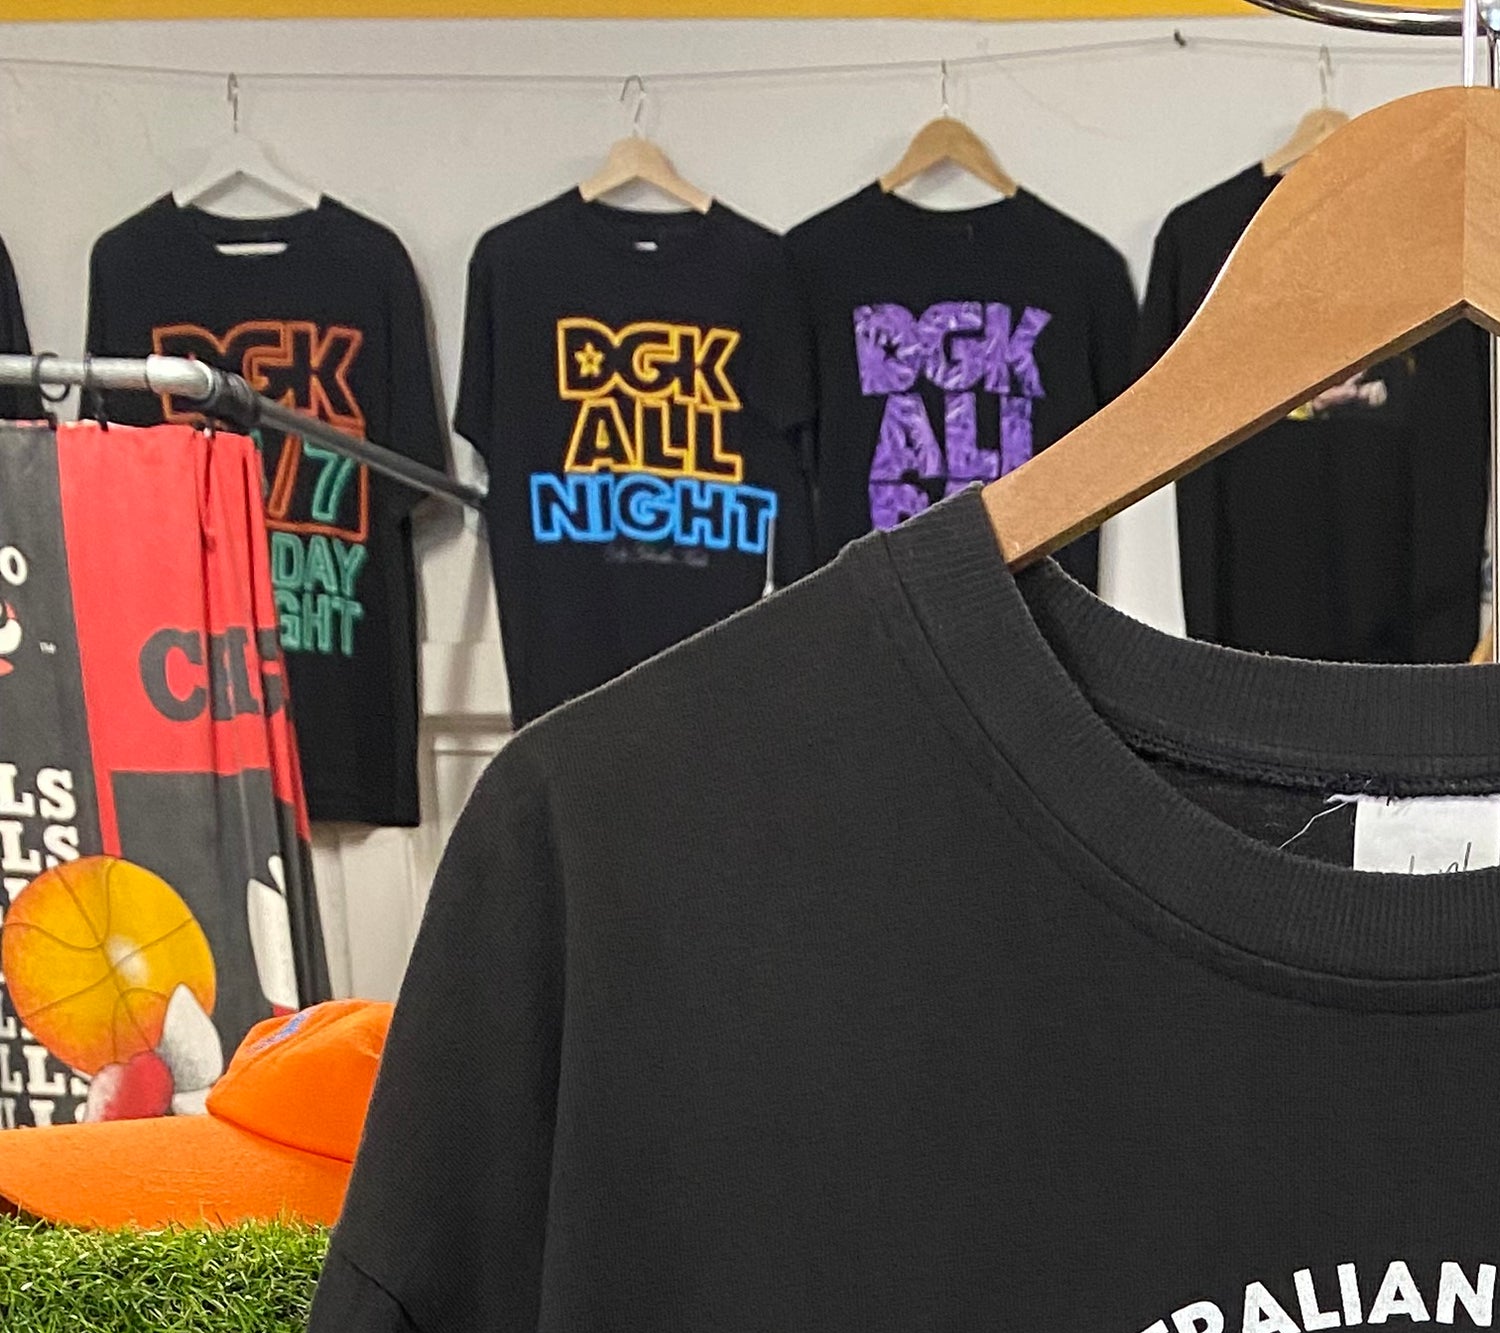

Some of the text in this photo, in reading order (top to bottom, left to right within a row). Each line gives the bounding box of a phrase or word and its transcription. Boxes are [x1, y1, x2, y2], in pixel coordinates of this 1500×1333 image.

[557, 317, 743, 411] DGK
[853, 300, 1052, 398] DGK
[564, 398, 743, 482] ALL
[530, 472, 777, 554] NIGHT
[271, 531, 368, 597] DAY
